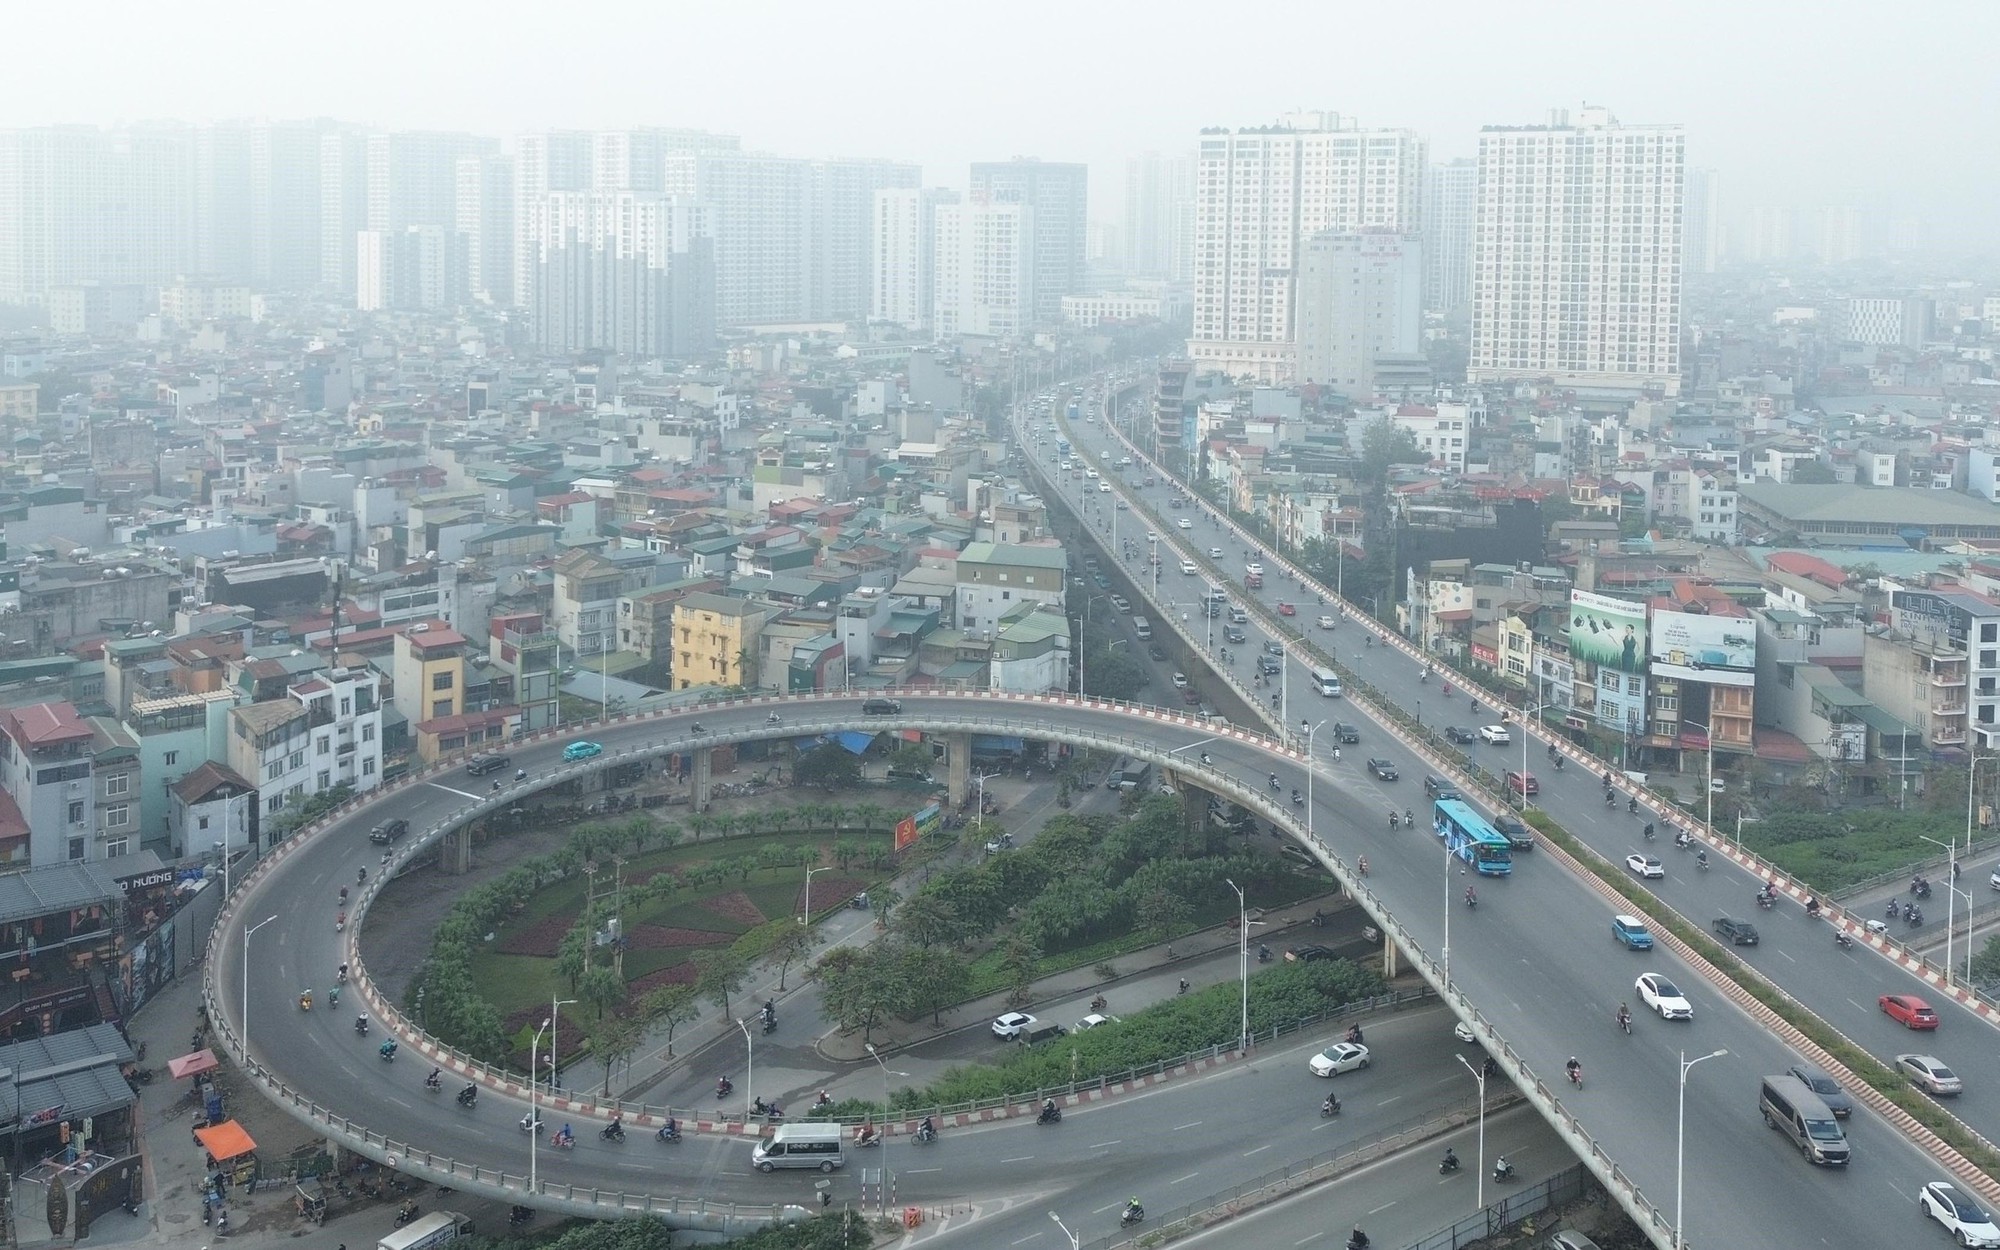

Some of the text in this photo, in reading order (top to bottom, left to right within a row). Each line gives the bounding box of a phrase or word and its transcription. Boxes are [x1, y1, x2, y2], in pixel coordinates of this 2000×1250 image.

[996, 189, 1020, 202] MB
[1906, 596, 1955, 616] LILY
[133, 872, 173, 889] NƯỚNG
